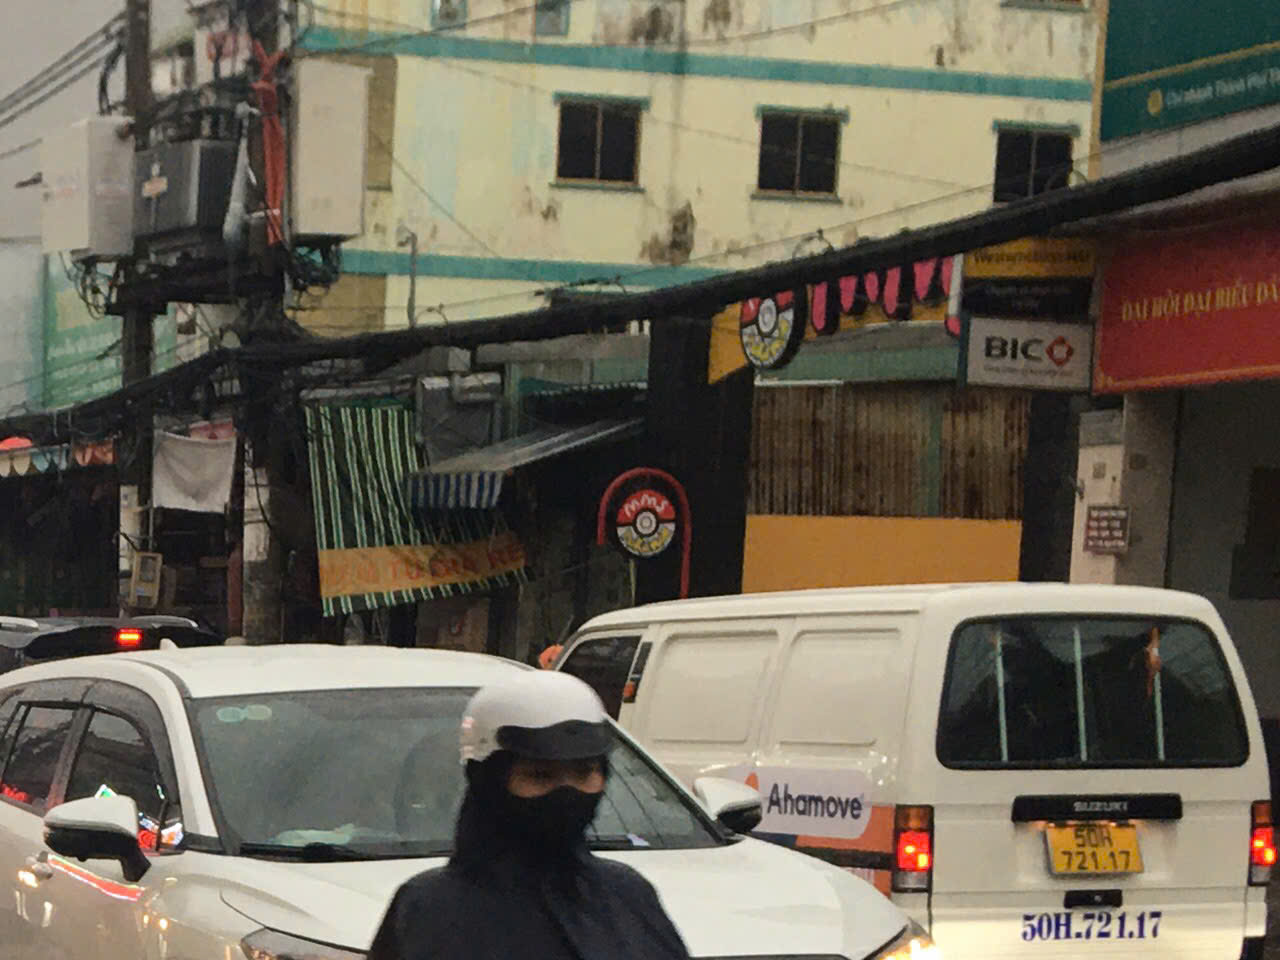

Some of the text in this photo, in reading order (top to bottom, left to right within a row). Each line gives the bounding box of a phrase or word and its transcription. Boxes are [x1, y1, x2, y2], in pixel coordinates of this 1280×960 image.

[984, 336, 1044, 361] BIC
[766, 783, 863, 820] Ahamove
[1073, 801, 1129, 812] SUZUKI
[1061, 850, 1131, 871] 721.17
[1021, 911, 1163, 941] 50H.721.17
